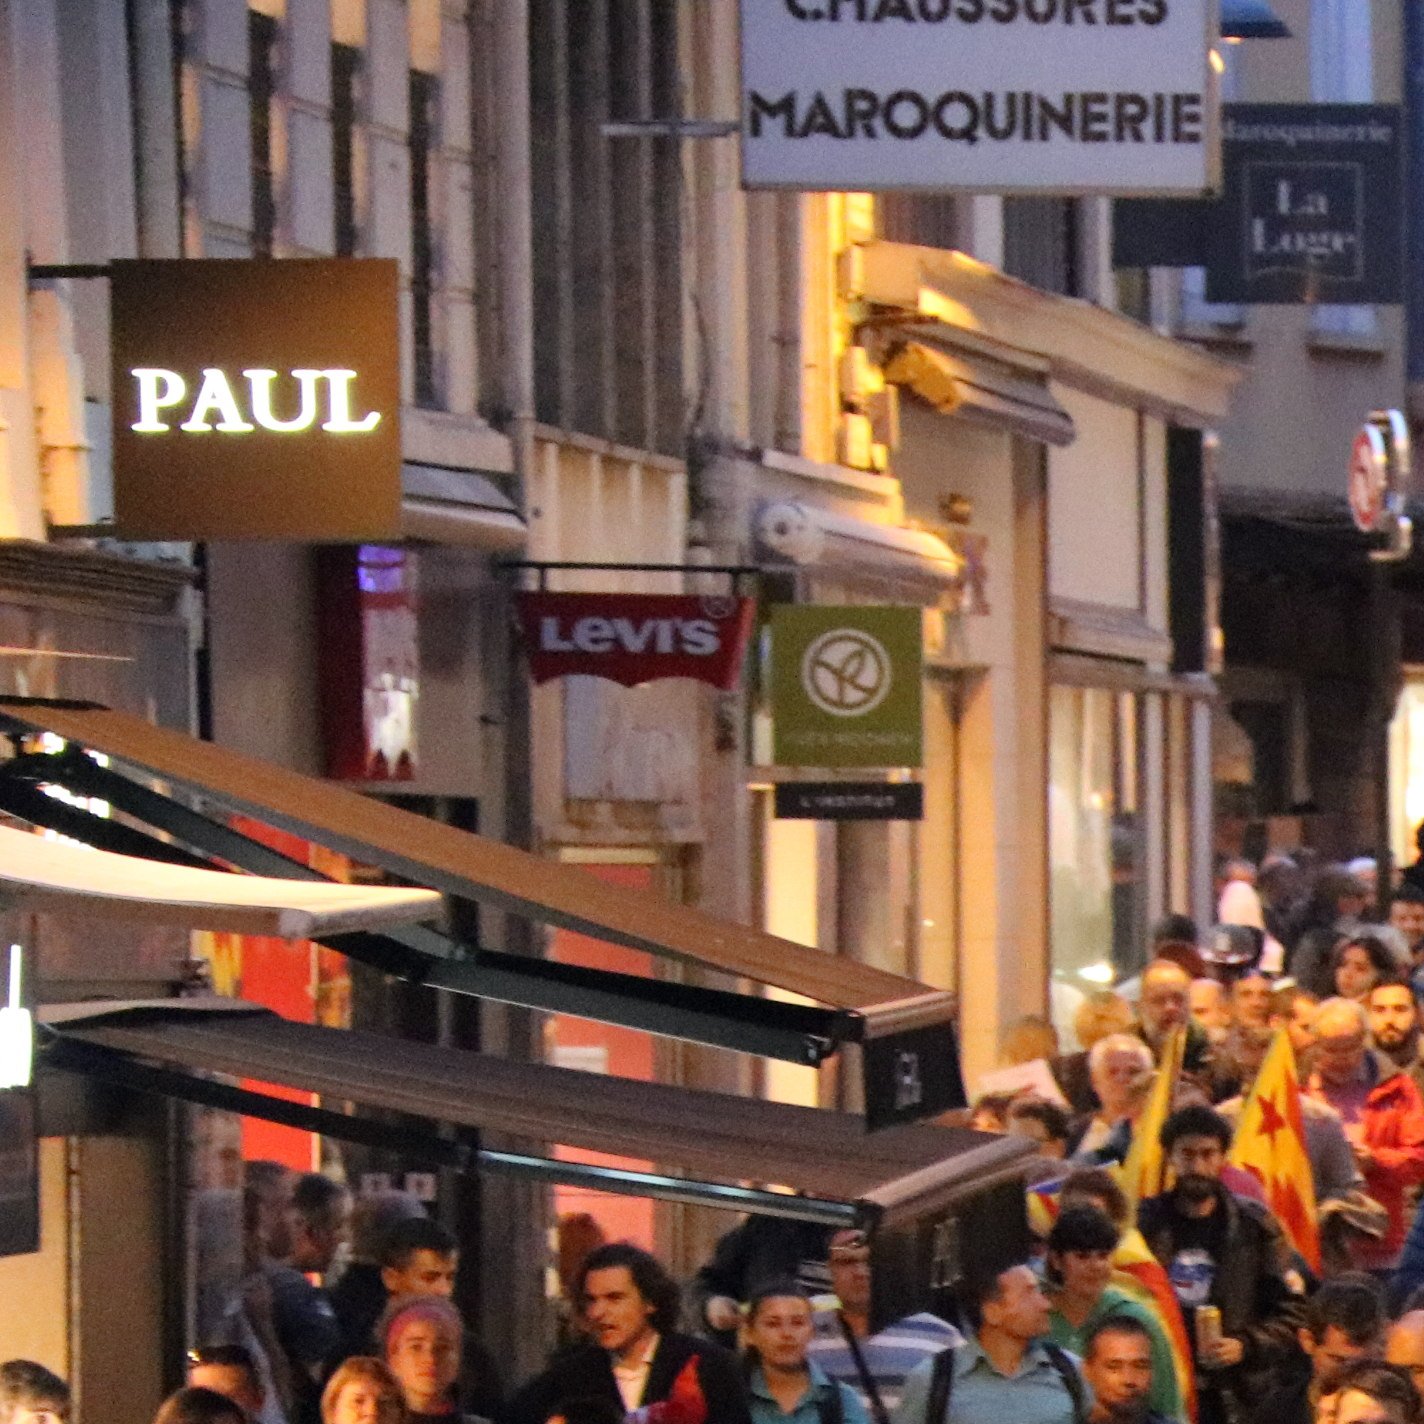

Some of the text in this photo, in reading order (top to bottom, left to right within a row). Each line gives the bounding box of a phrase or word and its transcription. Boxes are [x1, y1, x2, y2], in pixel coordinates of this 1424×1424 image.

[748, 88, 1202, 145] MAROQUINERIE
[1276, 179, 1329, 215] La
[131, 368, 381, 434] PAUL
